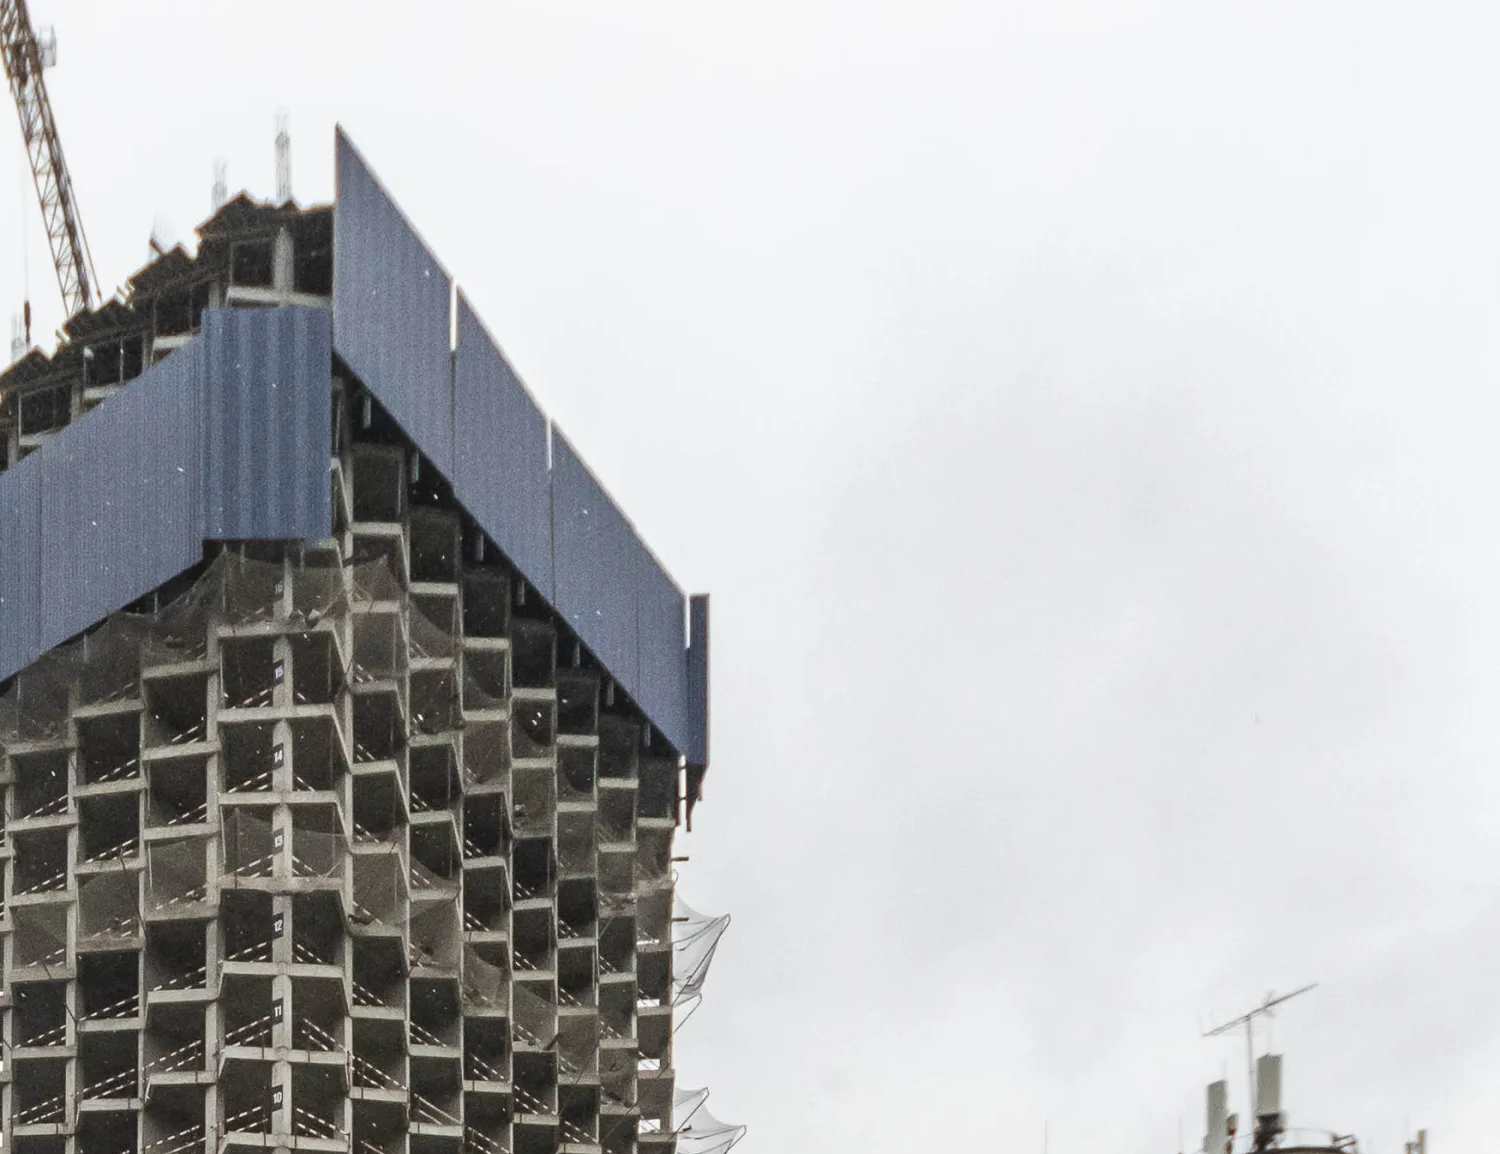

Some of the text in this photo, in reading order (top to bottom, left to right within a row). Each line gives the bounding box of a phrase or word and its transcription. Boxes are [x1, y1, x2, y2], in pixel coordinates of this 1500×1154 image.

[274, 749, 283, 763] 14
[274, 835, 283, 848] 13
[273, 919, 283, 932] 12
[274, 1005, 282, 1018] 11
[273, 1091, 283, 1104] 10
